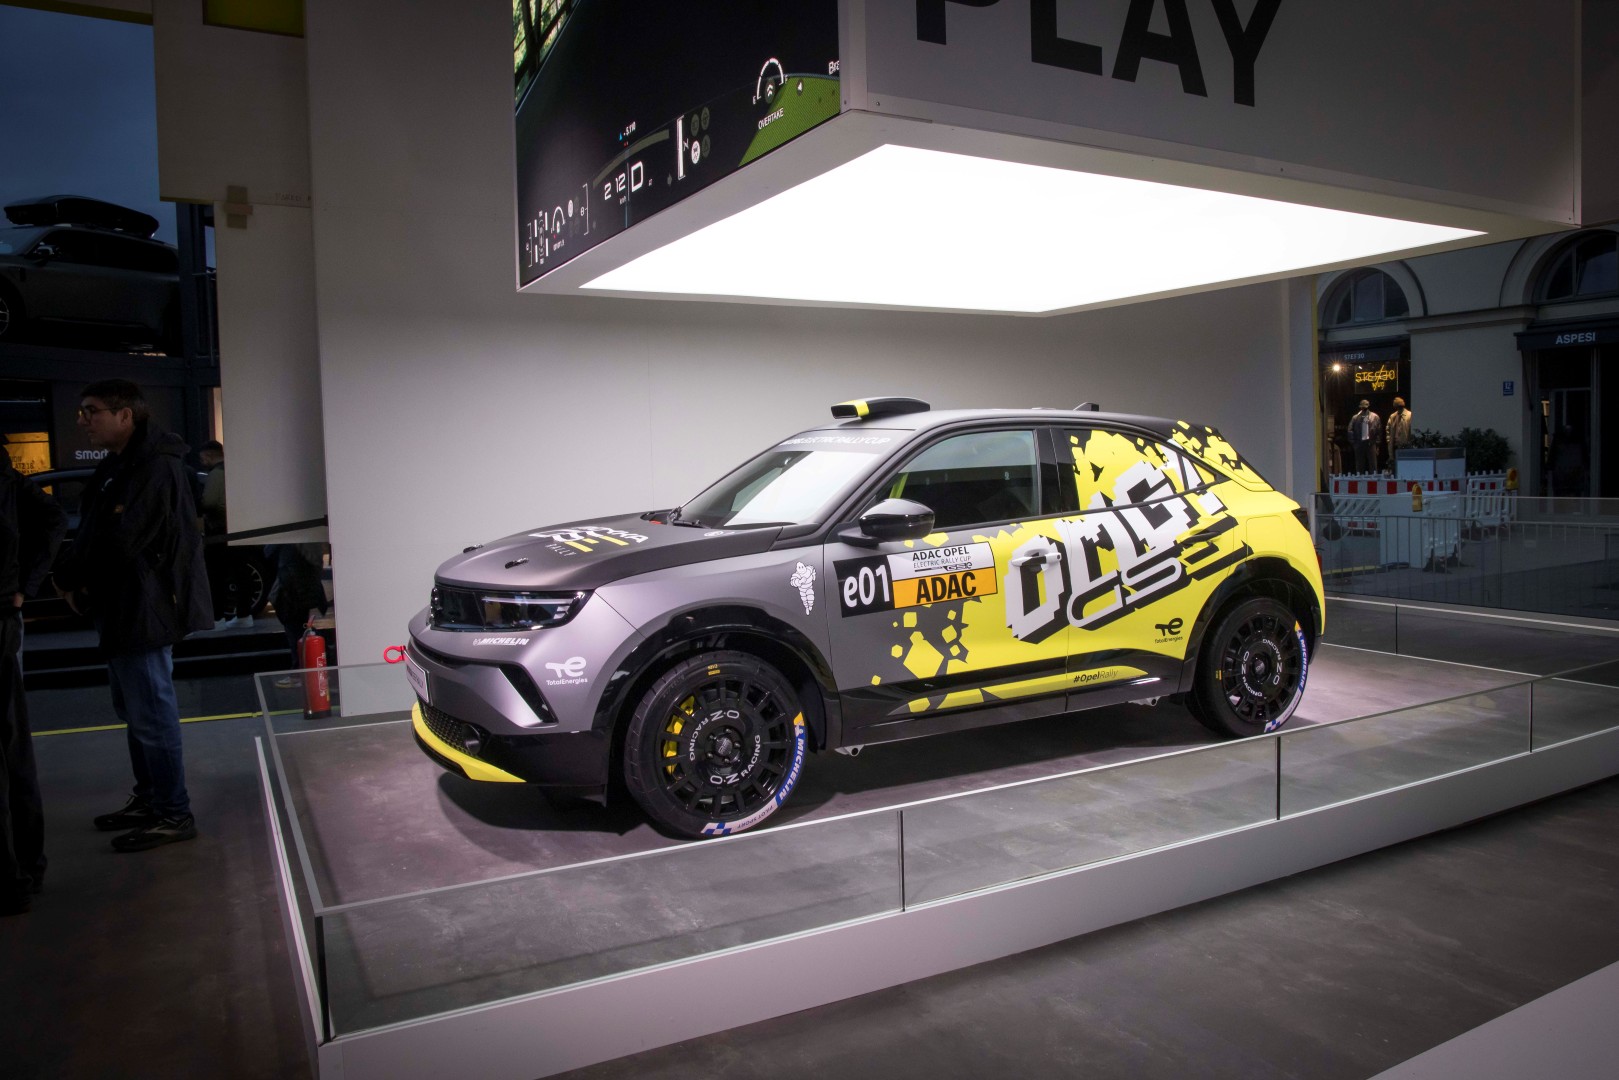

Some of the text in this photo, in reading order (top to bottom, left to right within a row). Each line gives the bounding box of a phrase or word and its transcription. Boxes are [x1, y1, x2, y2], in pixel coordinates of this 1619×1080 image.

[758, 108, 784, 130] OVERTAKE
[1555, 331, 1596, 345] ASPESI
[75, 448, 109, 460] smart
[912, 546, 970, 561] ADAC OPEL
[913, 559, 940, 568] ELECTRIC
[941, 557, 959, 565] RALLY
[843, 564, 890, 608] e01
[916, 571, 976, 604] ADAC
[479, 637, 530, 646] MICHELIN
[1154, 636, 1184, 644] TotalEnergies
[1299, 639, 1308, 688] MICHELIN
[545, 677, 588, 686] TotalEnergies
[689, 717, 709, 761] RACING
[740, 734, 761, 778] RACING
[778, 737, 805, 801] MICHELIN
